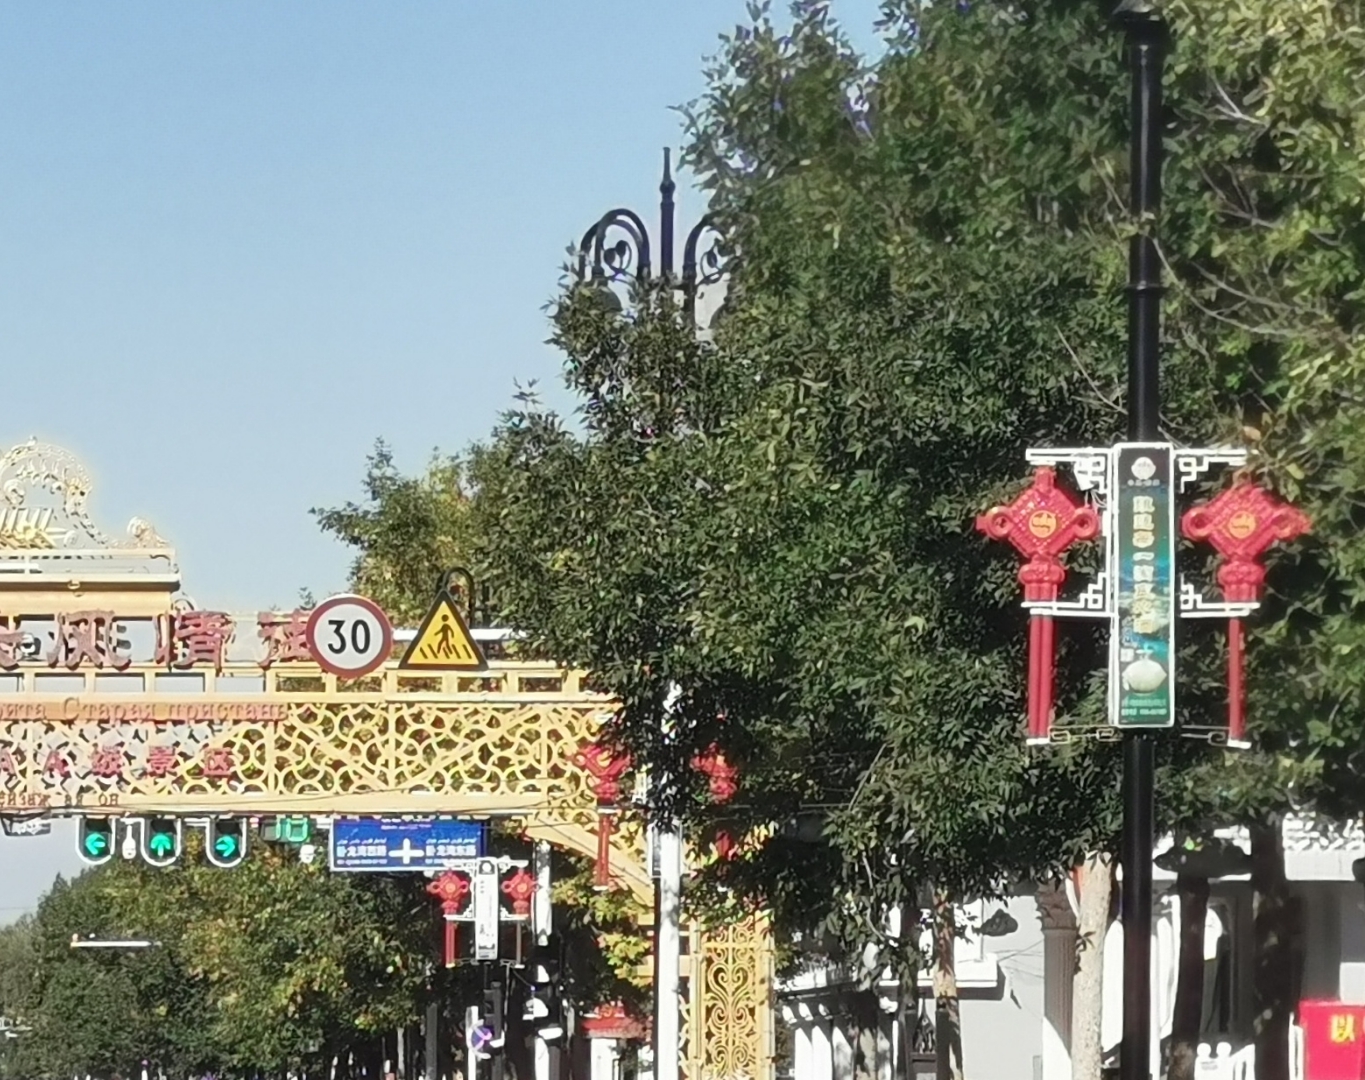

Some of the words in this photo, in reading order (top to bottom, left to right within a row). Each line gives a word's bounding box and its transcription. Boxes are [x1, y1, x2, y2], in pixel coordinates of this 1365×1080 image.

[328, 619, 371, 654] 30
[63, 697, 156, 726] Старая
[169, 702, 289, 726] пристань
[1331, 1013, 1355, 1043] 以
